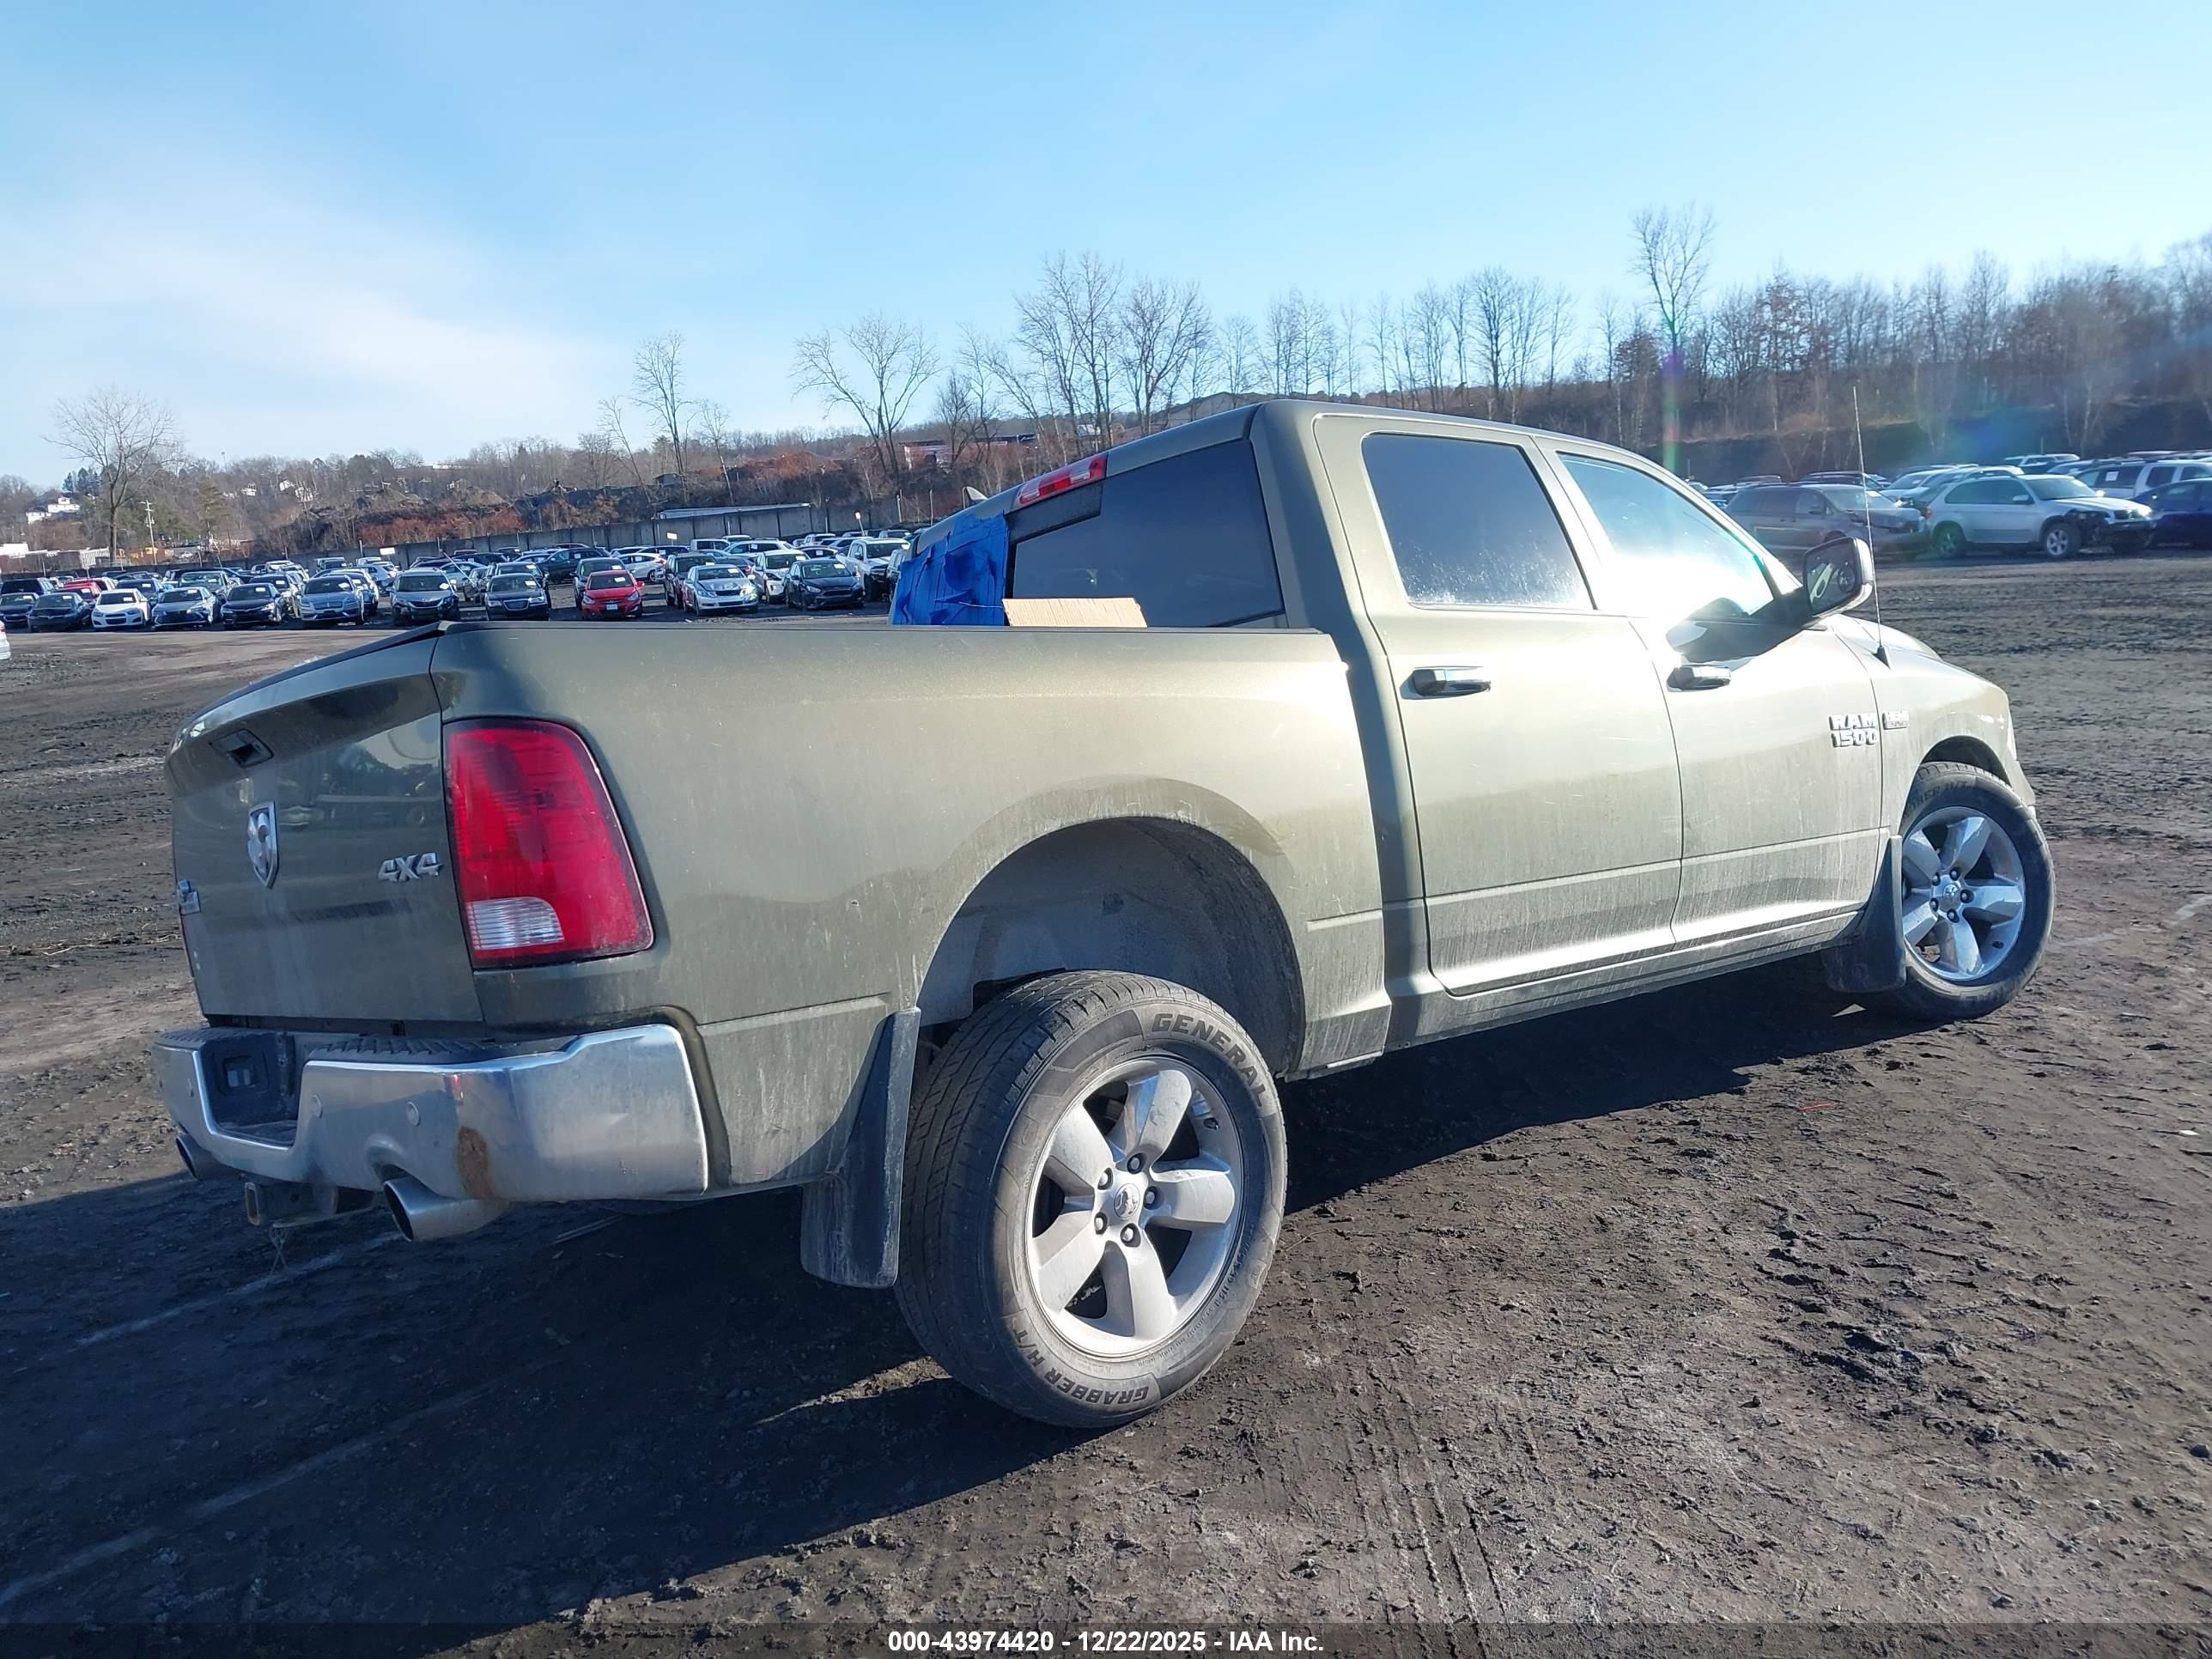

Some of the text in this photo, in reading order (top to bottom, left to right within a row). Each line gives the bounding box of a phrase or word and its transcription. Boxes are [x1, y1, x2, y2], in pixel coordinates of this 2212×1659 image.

[1829, 713, 1877, 730] RAM
[1831, 730, 1879, 747] 1500
[1152, 1013, 1267, 1108] GENERAL
[1013, 1327, 1149, 1405] GRABBER H/T
